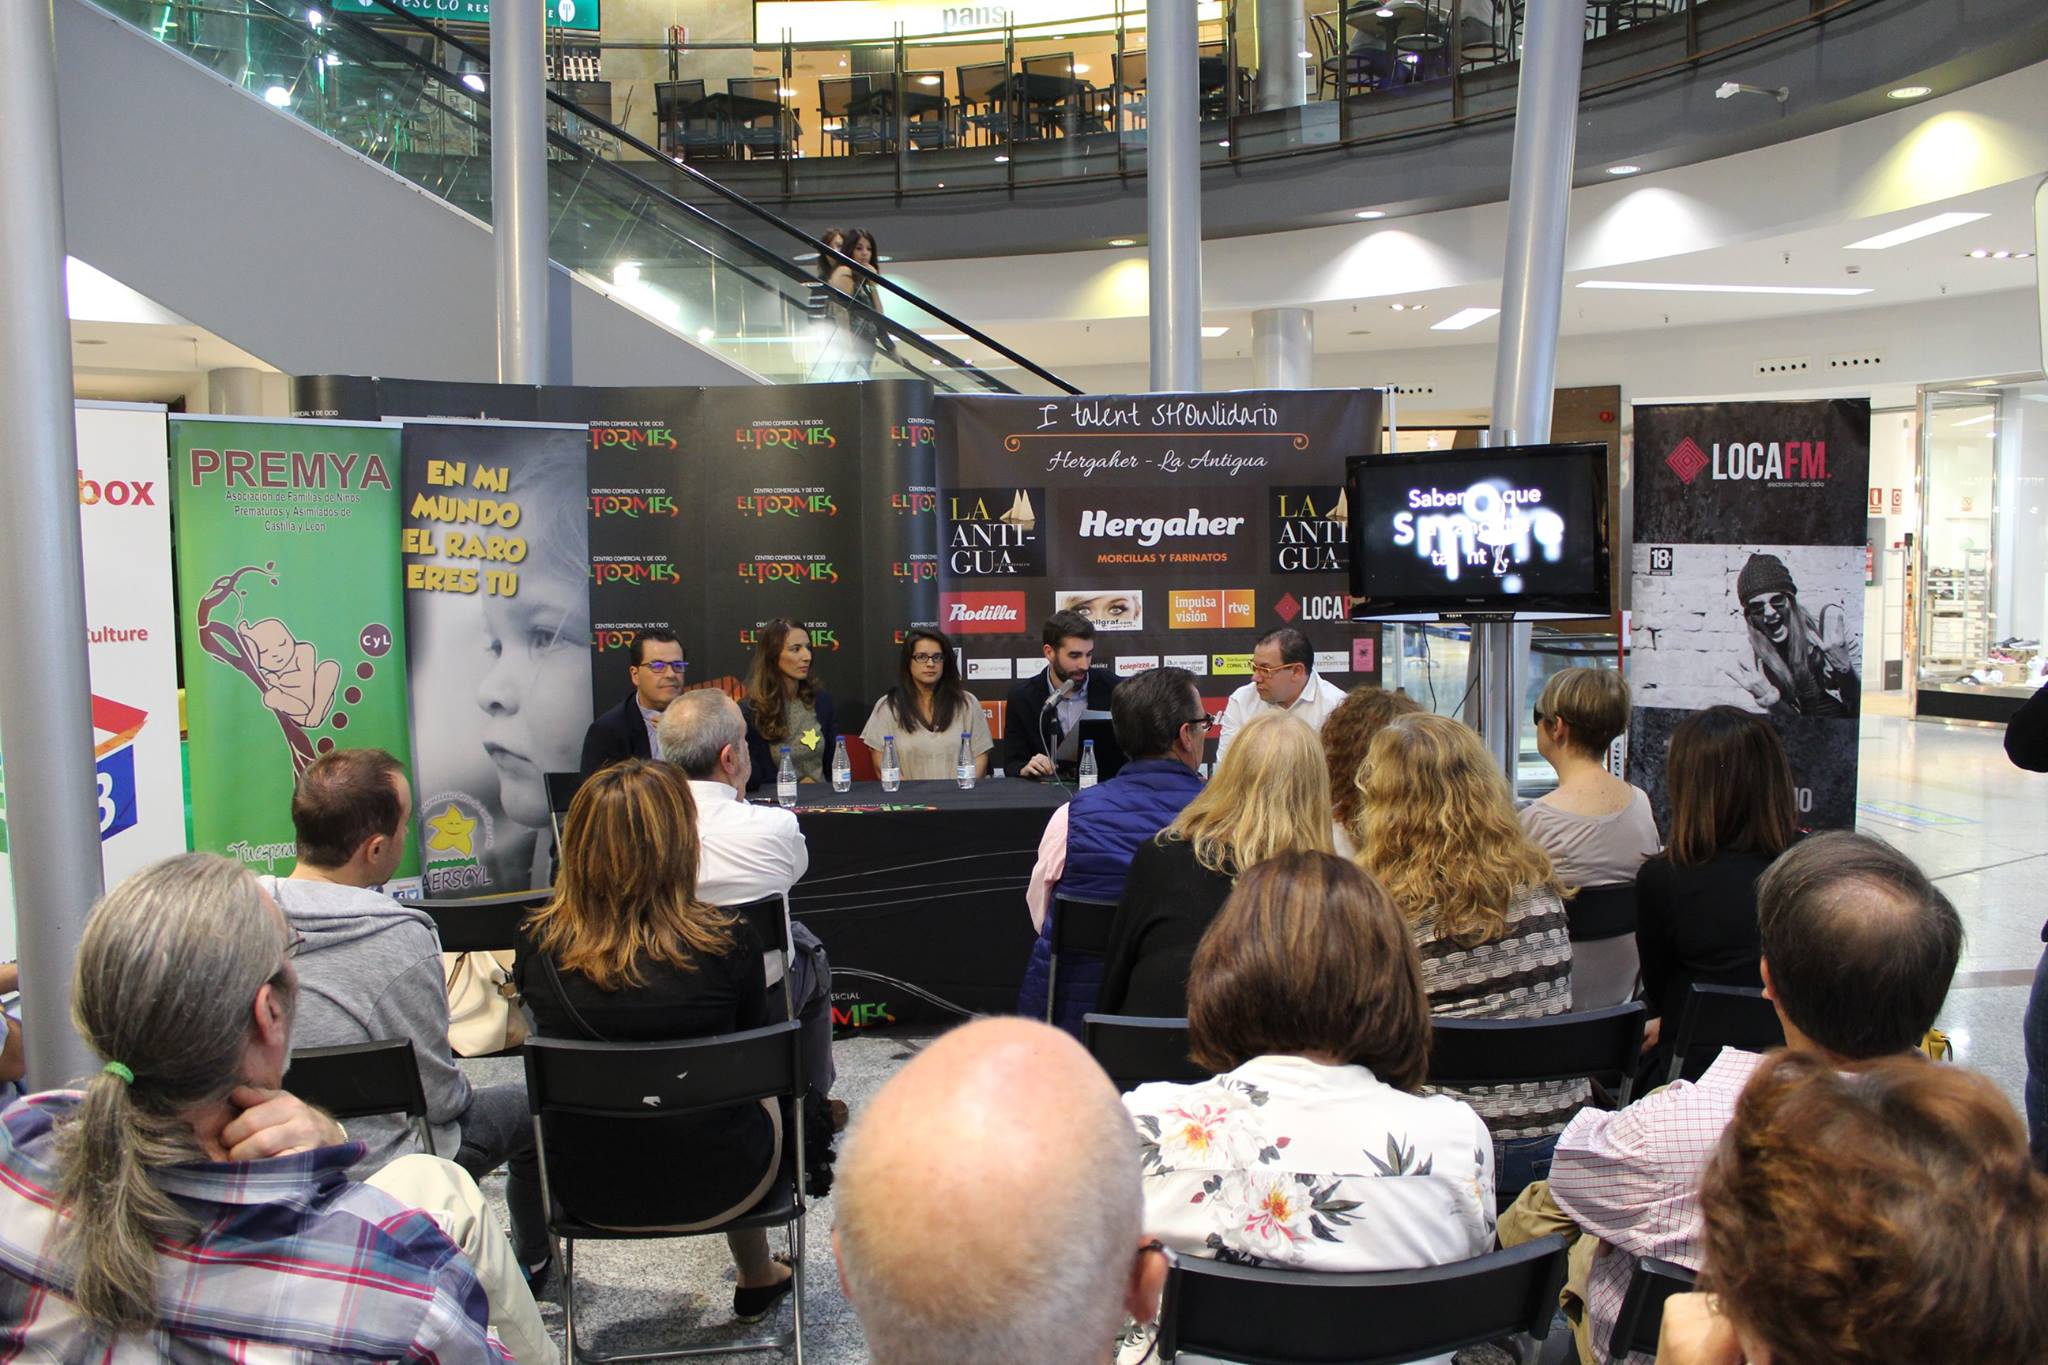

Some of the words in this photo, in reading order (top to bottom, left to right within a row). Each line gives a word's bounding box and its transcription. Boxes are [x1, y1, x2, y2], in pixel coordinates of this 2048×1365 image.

[942, 5, 1005, 34] pans
[1037, 403, 1059, 430] I
[1071, 402, 1142, 427] talent
[591, 428, 678, 450] TORMES
[736, 428, 753, 442] EL
[753, 427, 837, 449] TORMES
[190, 448, 393, 491] PREMYA
[1046, 449, 1139, 477] Hergaher
[1157, 450, 1184, 472] La
[1188, 450, 1268, 476] Antigua
[427, 460, 467, 487] EN
[472, 464, 510, 492] MI
[288, 491, 321, 503] Familias
[592, 496, 679, 518] TORMES
[737, 495, 755, 510] EL
[753, 495, 838, 517] TORMES
[950, 496, 992, 521] LA
[1278, 494, 1318, 518] LA
[235, 505, 283, 517] Prematuros
[293, 506, 339, 518] Asimilados
[411, 493, 520, 528] MUNDO
[265, 520, 296, 532] Castilla
[950, 524, 1036, 547] ANTI-
[1079, 508, 1245, 547] Hergaher
[402, 528, 437, 556] EL
[445, 532, 527, 563] RARO
[951, 550, 1018, 575] GUA
[1097, 553, 1156, 564] MORCILLAS
[1159, 553, 1168, 563] Y
[1169, 552, 1228, 563] FARINATOS
[1278, 546, 1342, 571] GUA
[407, 564, 480, 594] ERES
[593, 563, 681, 585] TORMES
[738, 562, 756, 576] EL
[754, 562, 839, 584] TORMES
[949, 603, 1018, 621] Rodilla
[1175, 595, 1217, 611] impulsa
[1228, 602, 1250, 616] rtve
[1175, 611, 1208, 622] visión
